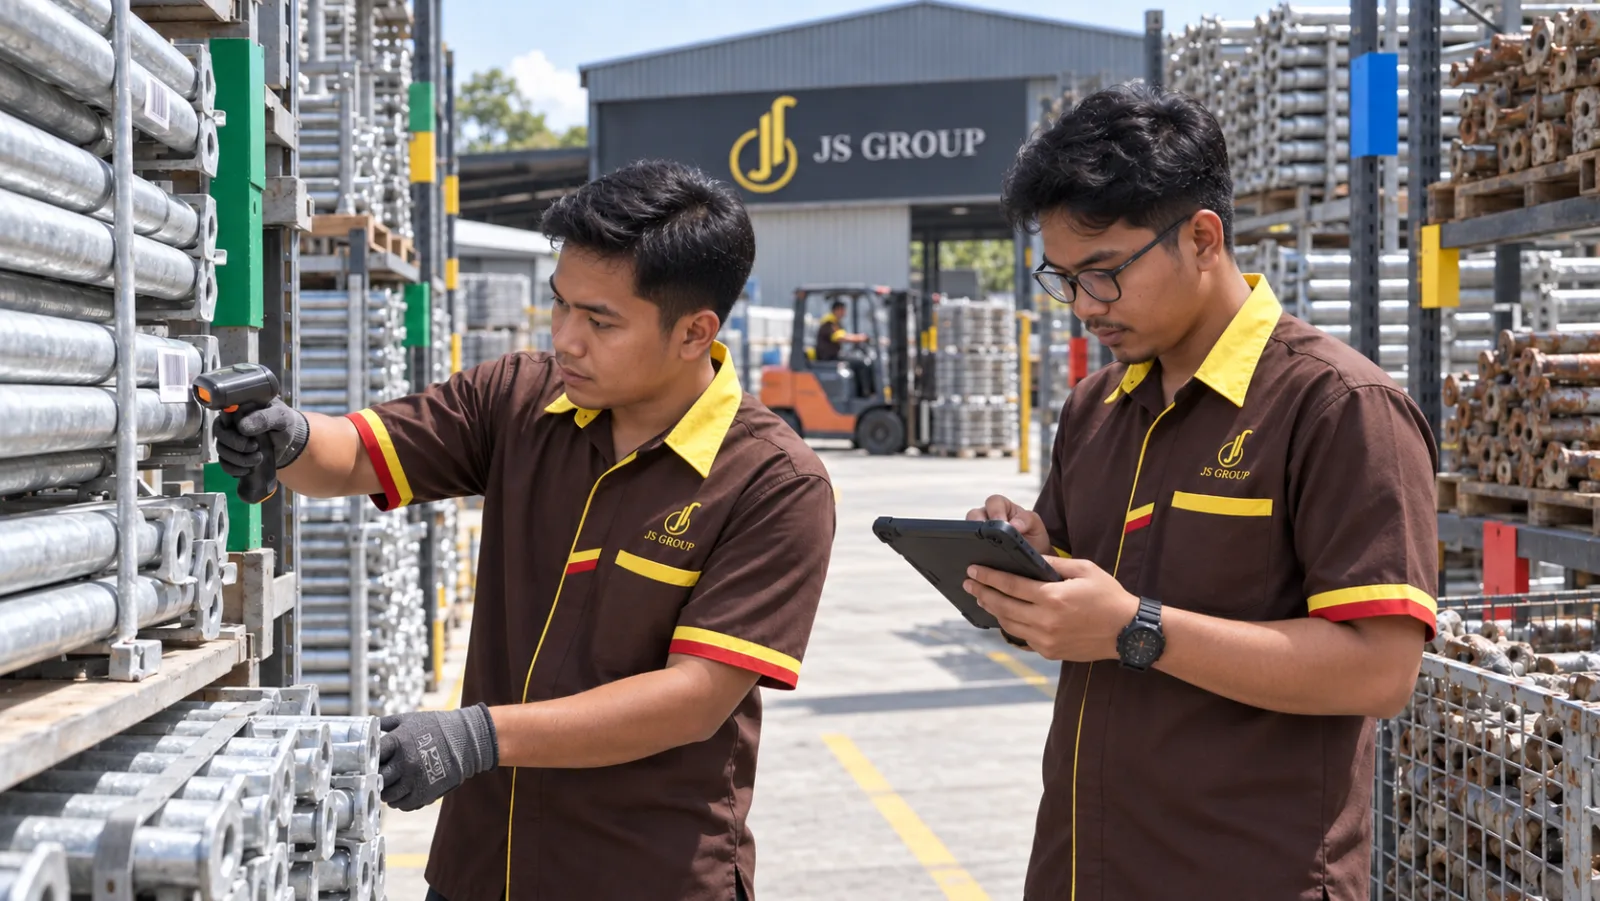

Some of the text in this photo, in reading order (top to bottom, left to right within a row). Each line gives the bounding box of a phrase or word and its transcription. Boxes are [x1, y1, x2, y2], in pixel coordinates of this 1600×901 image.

[813, 127, 985, 163] JS GROUP
[1200, 467, 1250, 480] JS GROUP
[644, 530, 695, 551] JS GROUP
